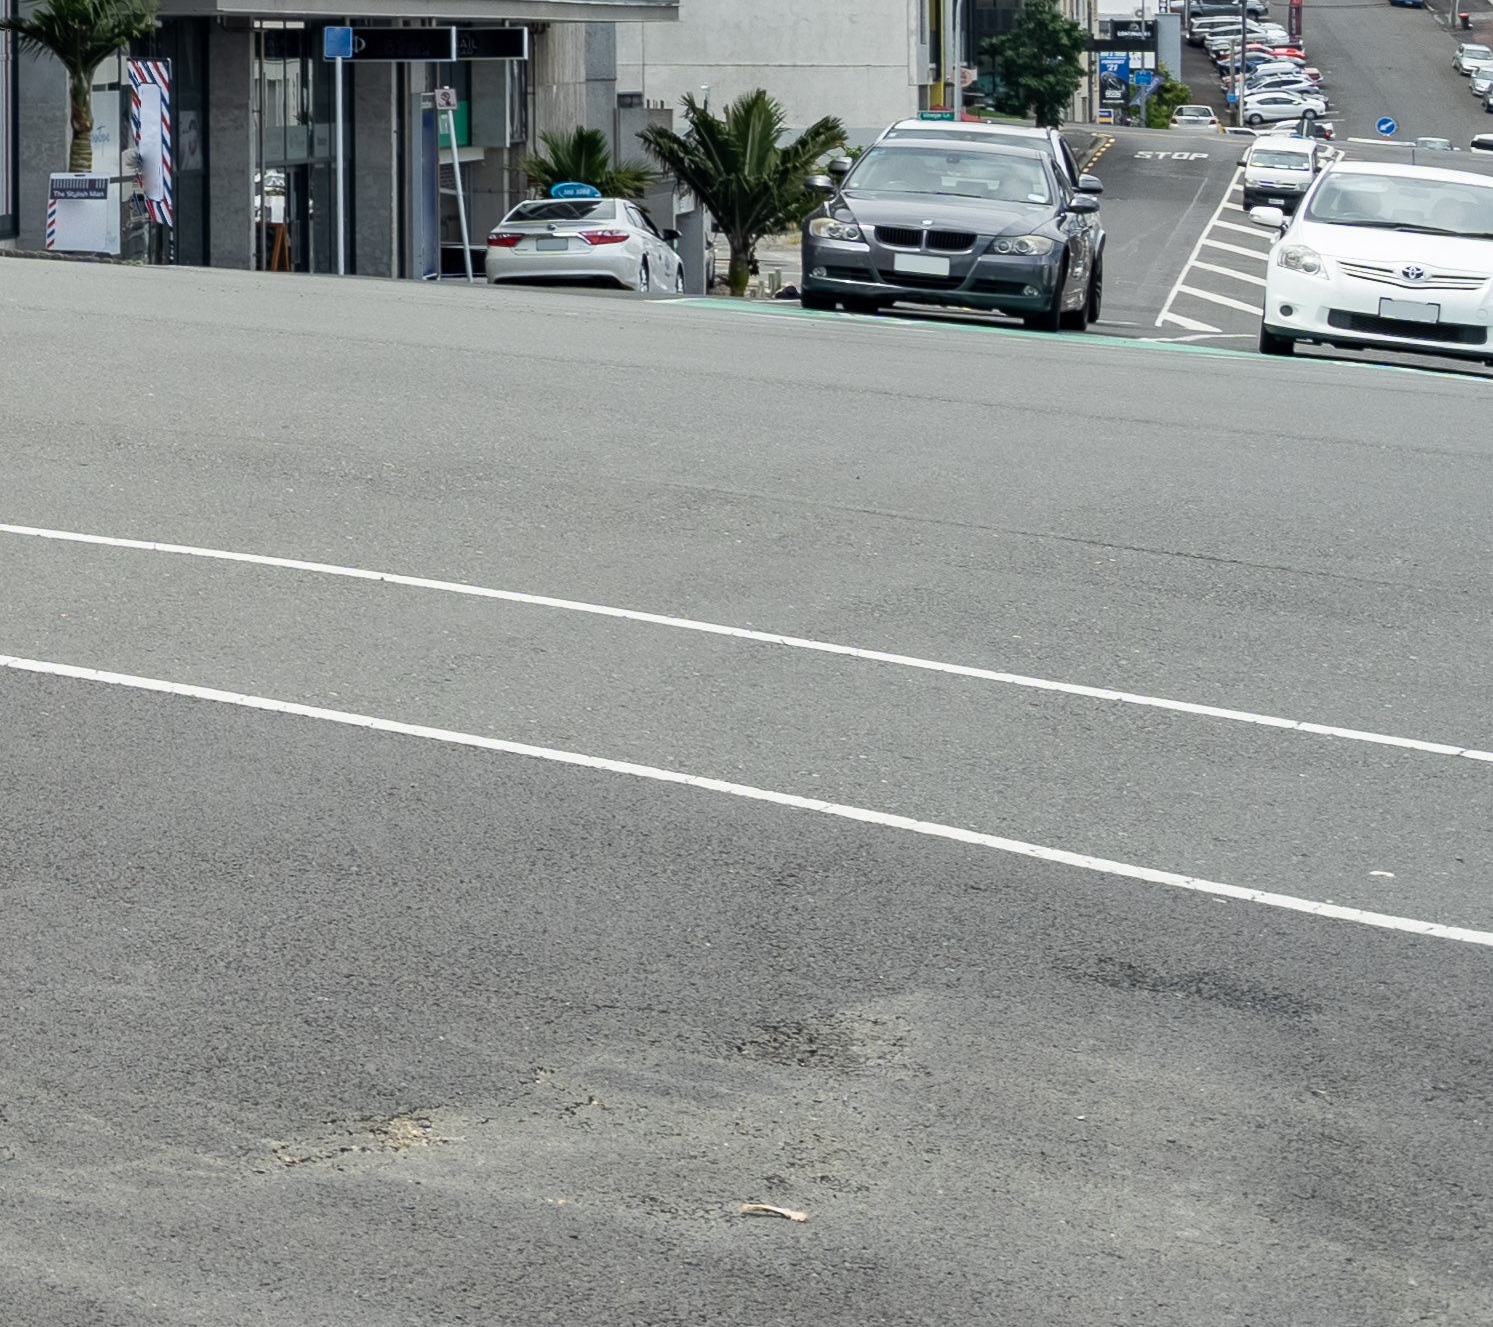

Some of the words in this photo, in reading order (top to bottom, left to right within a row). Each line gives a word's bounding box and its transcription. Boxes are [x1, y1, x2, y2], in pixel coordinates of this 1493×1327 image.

[1133, 150, 1210, 161] STOP
[66, 190, 89, 199] Stylish
[89, 190, 105, 198] Man
